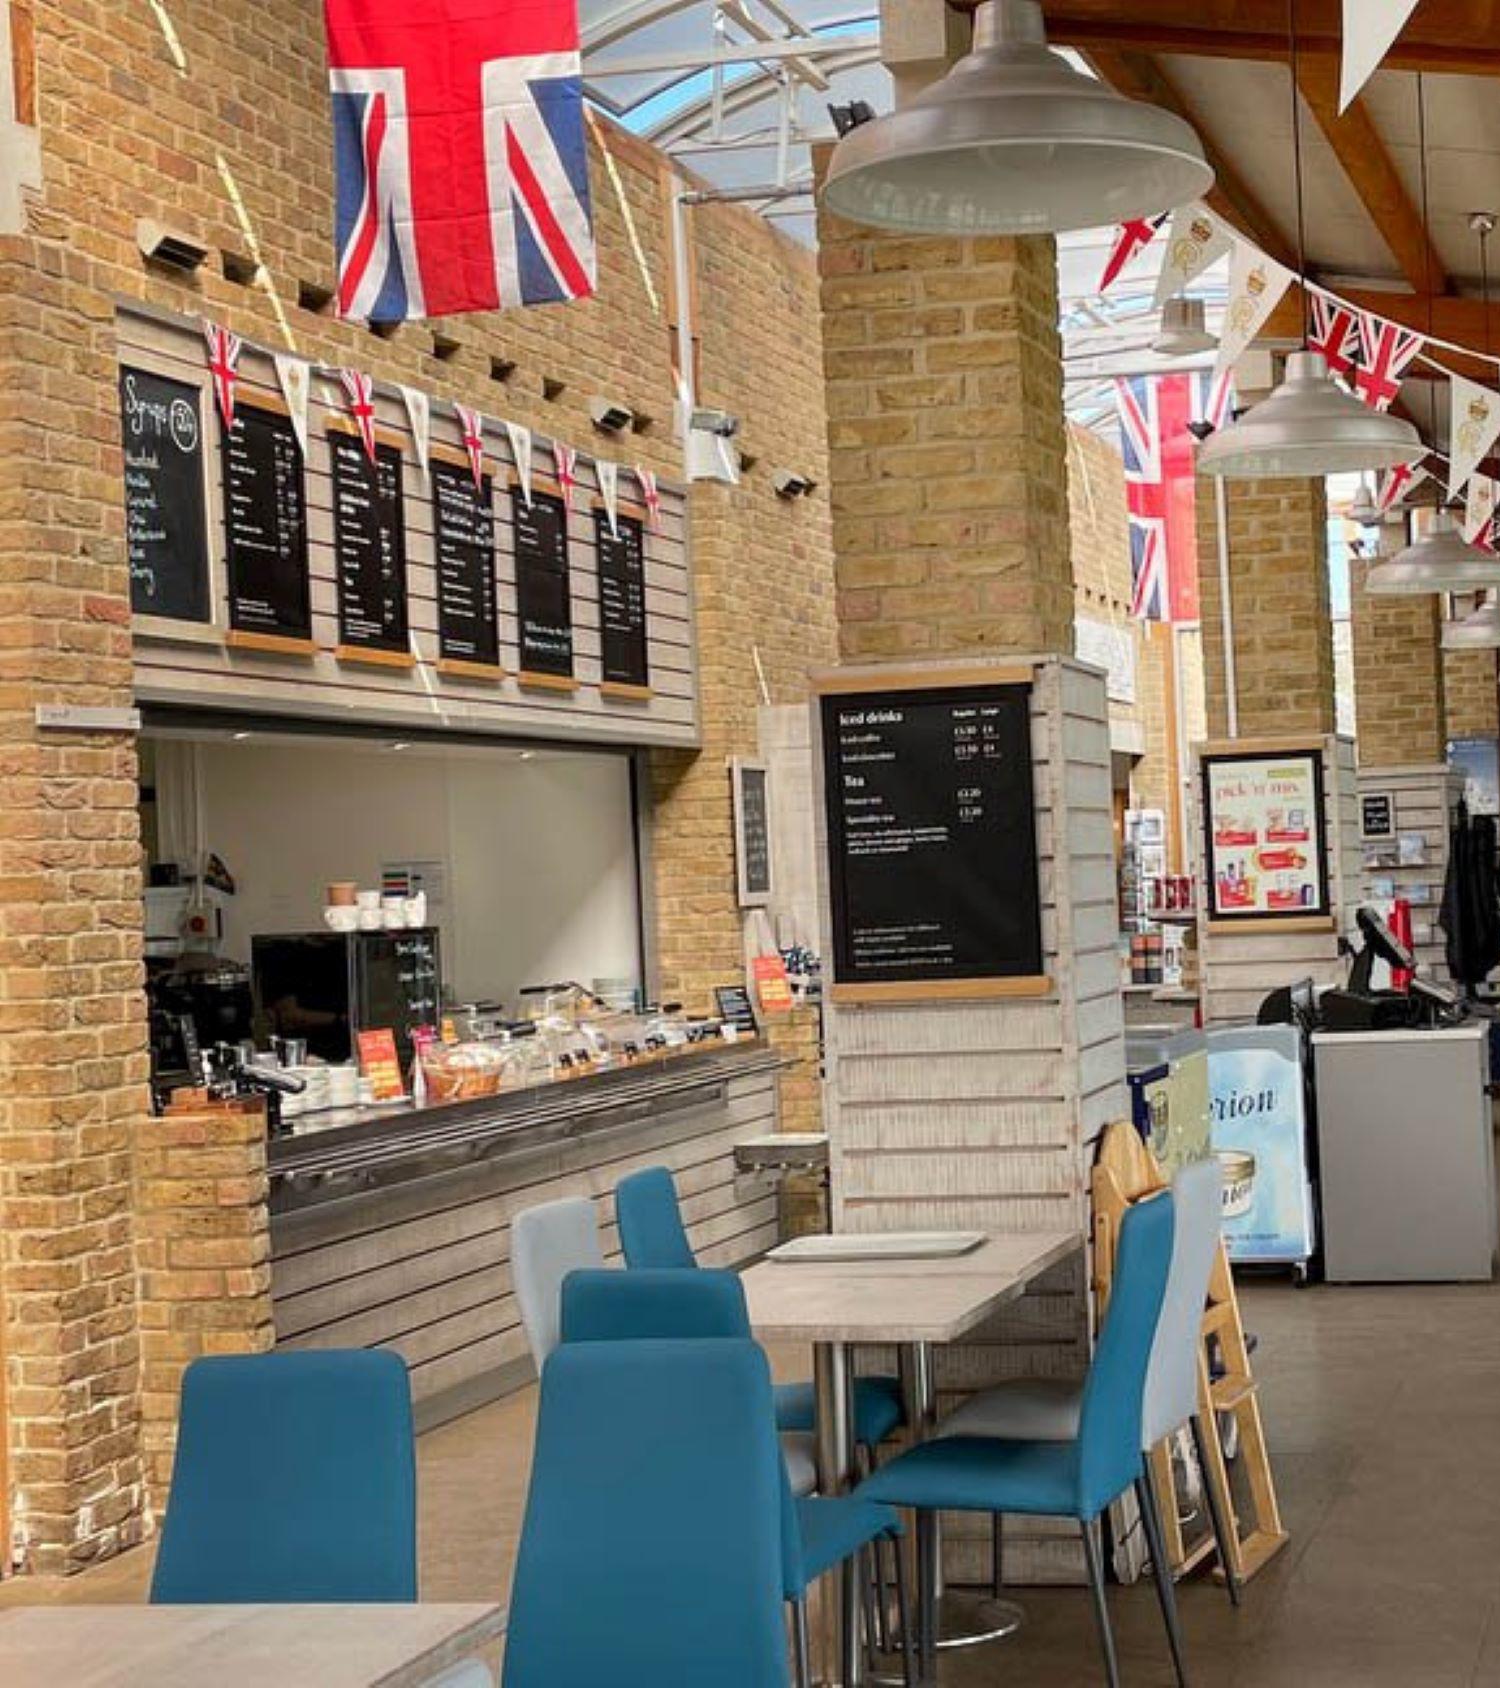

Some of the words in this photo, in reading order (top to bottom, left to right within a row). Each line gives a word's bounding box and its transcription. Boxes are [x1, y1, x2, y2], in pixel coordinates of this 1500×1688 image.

[840, 711, 865, 727] Iced
[866, 709, 903, 724] drinks
[843, 775, 865, 787] Tea
